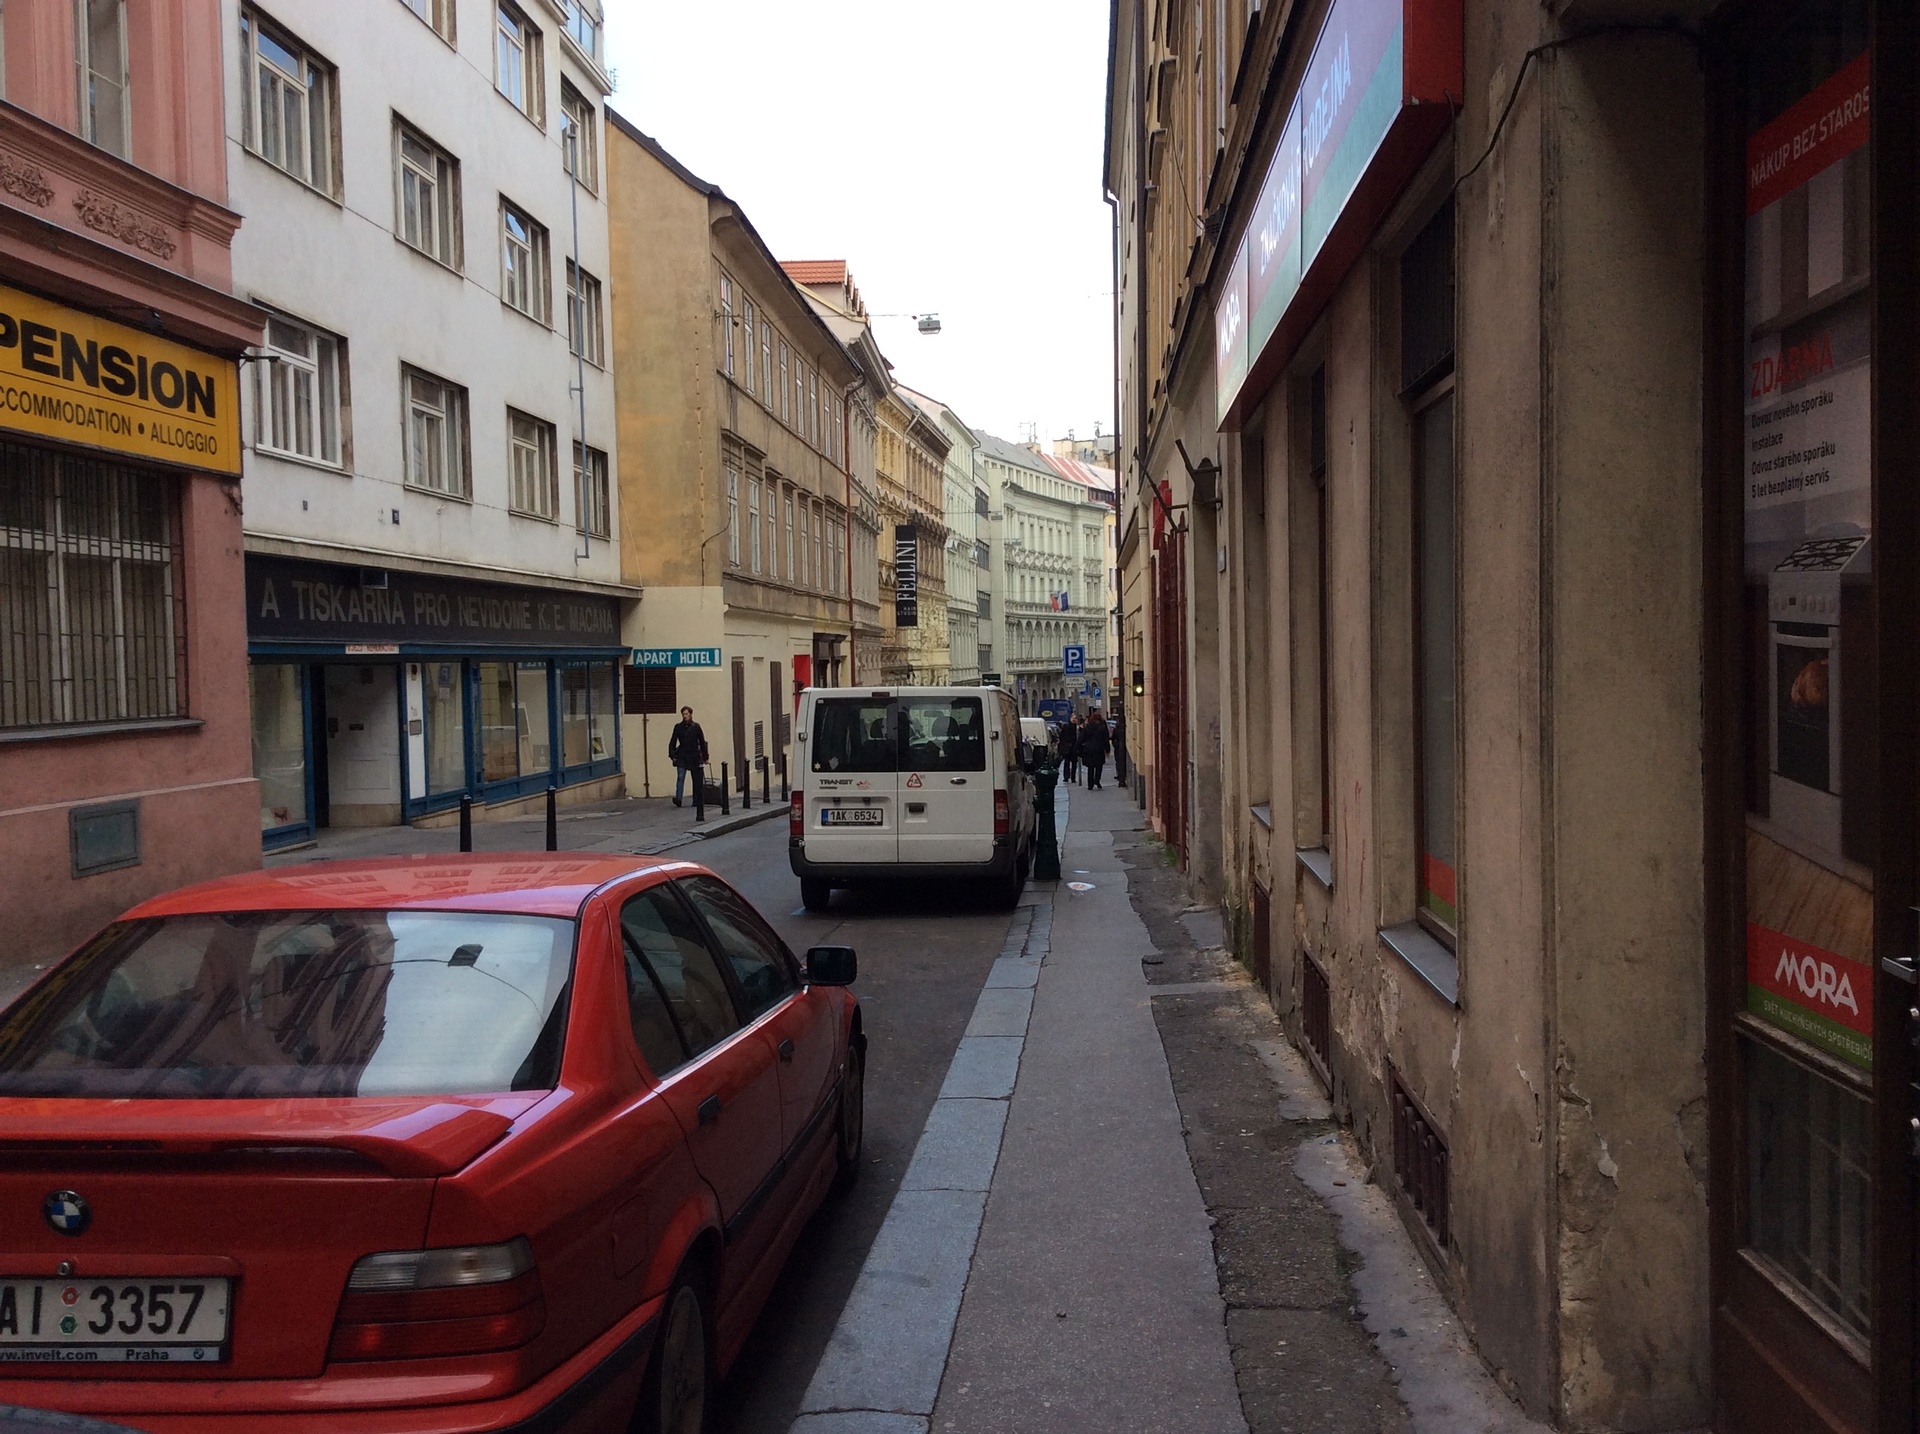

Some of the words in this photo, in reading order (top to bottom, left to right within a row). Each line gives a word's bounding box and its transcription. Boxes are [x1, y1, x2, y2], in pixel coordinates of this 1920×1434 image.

[1750, 142, 1791, 189] NÁKUP
[1793, 122, 1817, 160] BEZ
[1219, 284, 1241, 367] MORA
[1751, 329, 1834, 398] ZDARMA
[1752, 410, 1773, 429] Dovoz
[1773, 400, 1800, 421] nového
[1801, 389, 1834, 416] sporáku
[150, 421, 218, 456] ALLOGGIO
[1752, 431, 1784, 451] Instalace
[1752, 457, 1773, 475] Odvoz
[1773, 449, 1802, 470] starého
[1803, 441, 1836, 466] sporáku
[1751, 482, 1756, 499] 5
[1757, 480, 1767, 497] let
[1768, 471, 1804, 496] bezplatný
[1805, 466, 1830, 487] servis
[896, 539, 917, 602] FELLINI
[260, 576, 281, 619] A
[412, 591, 451, 628] PRO
[457, 592, 532, 631] NEVIDOMÉ
[537, 602, 551, 632] K.
[553, 603, 565, 632] E.
[568, 604, 615, 634] MACANA
[635, 651, 673, 665] APART
[679, 651, 711, 664] HOTEL
[1068, 648, 1080, 667] P
[1094, 688, 1100, 696] P
[830, 811, 848, 821] 1AK
[854, 811, 878, 820] 6534
[1774, 948, 1859, 1017] MORA
[88, 1285, 206, 1335] 3357
[126, 1349, 170, 1361] Praha
